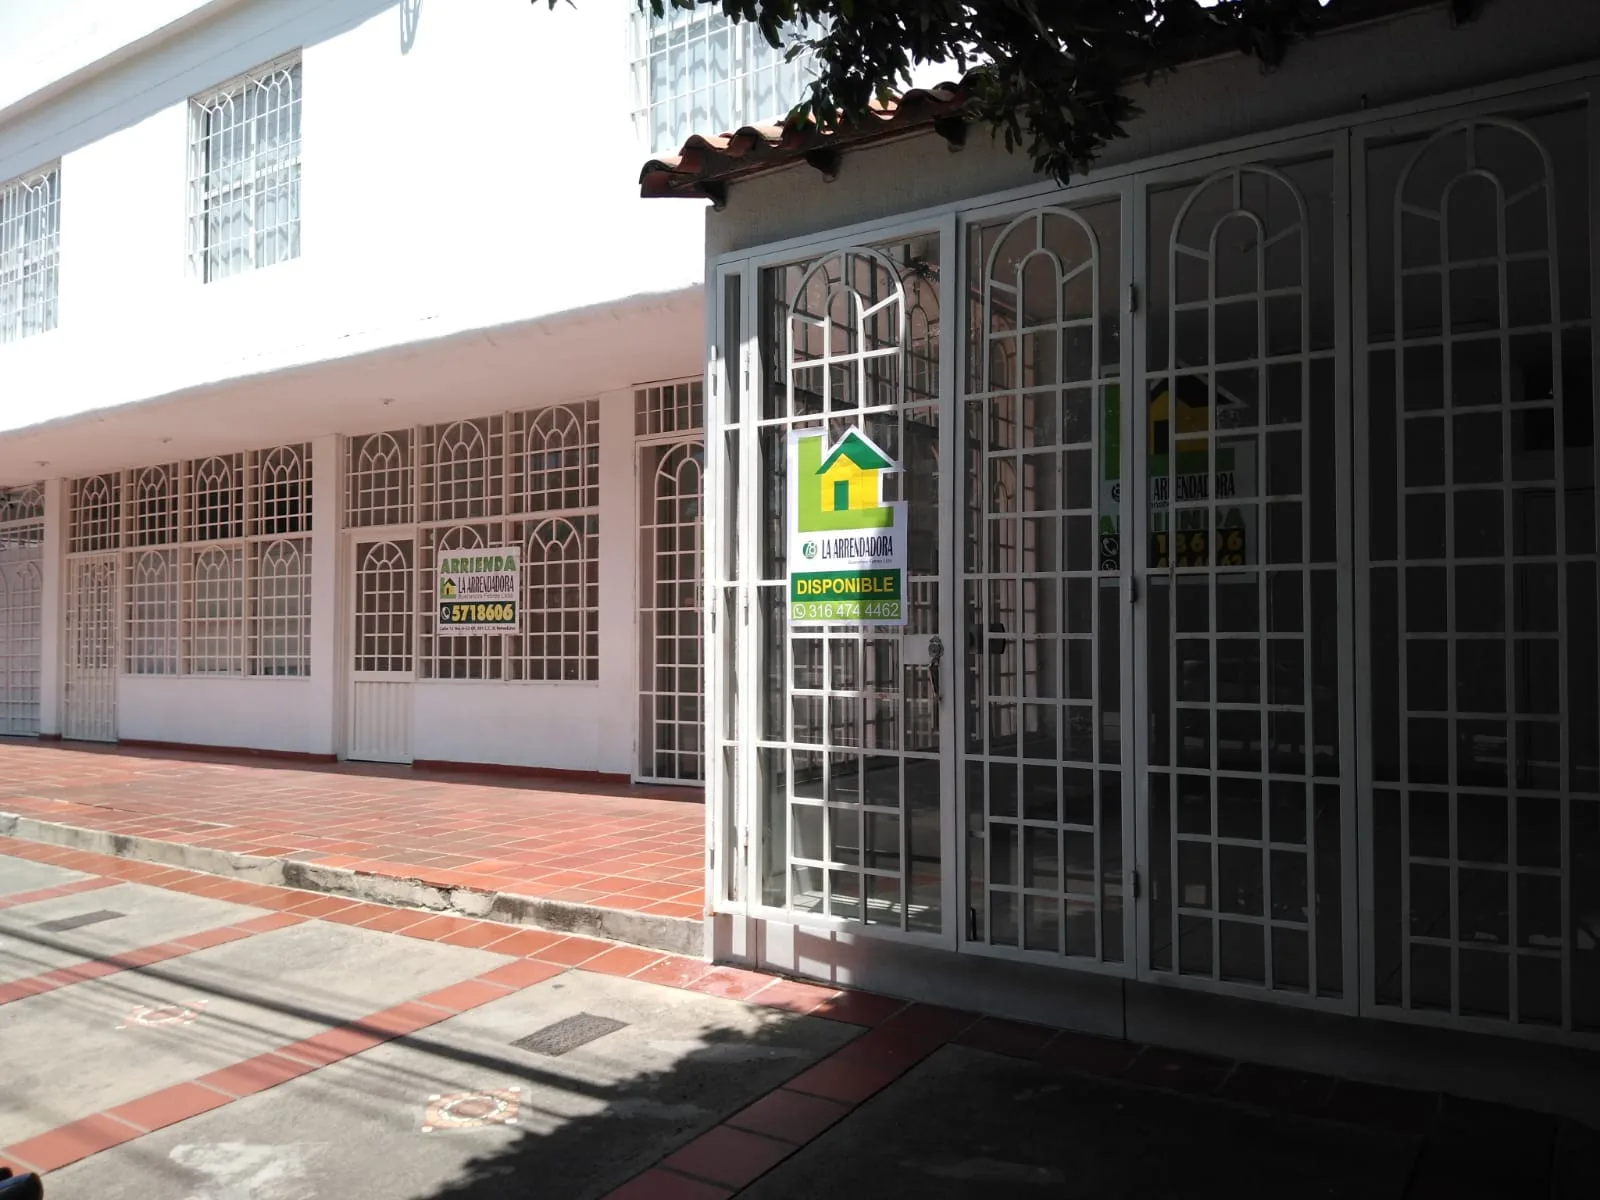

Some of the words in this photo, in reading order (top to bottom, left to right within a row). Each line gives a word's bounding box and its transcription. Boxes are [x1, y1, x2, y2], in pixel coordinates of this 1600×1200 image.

[1153, 473, 1235, 501] ARENDADRA
[822, 539, 832, 559] LA
[834, 535, 893, 559] ARRENDADORA
[441, 555, 516, 574] ARRIENDA
[458, 576, 466, 593] LA
[467, 575, 514, 593] ARRENDADORA
[797, 576, 894, 595] DISPONIBLE
[451, 603, 513, 622] 5718606
[809, 603, 833, 618] 316
[836, 603, 860, 617] 474
[864, 602, 899, 617] 4462
